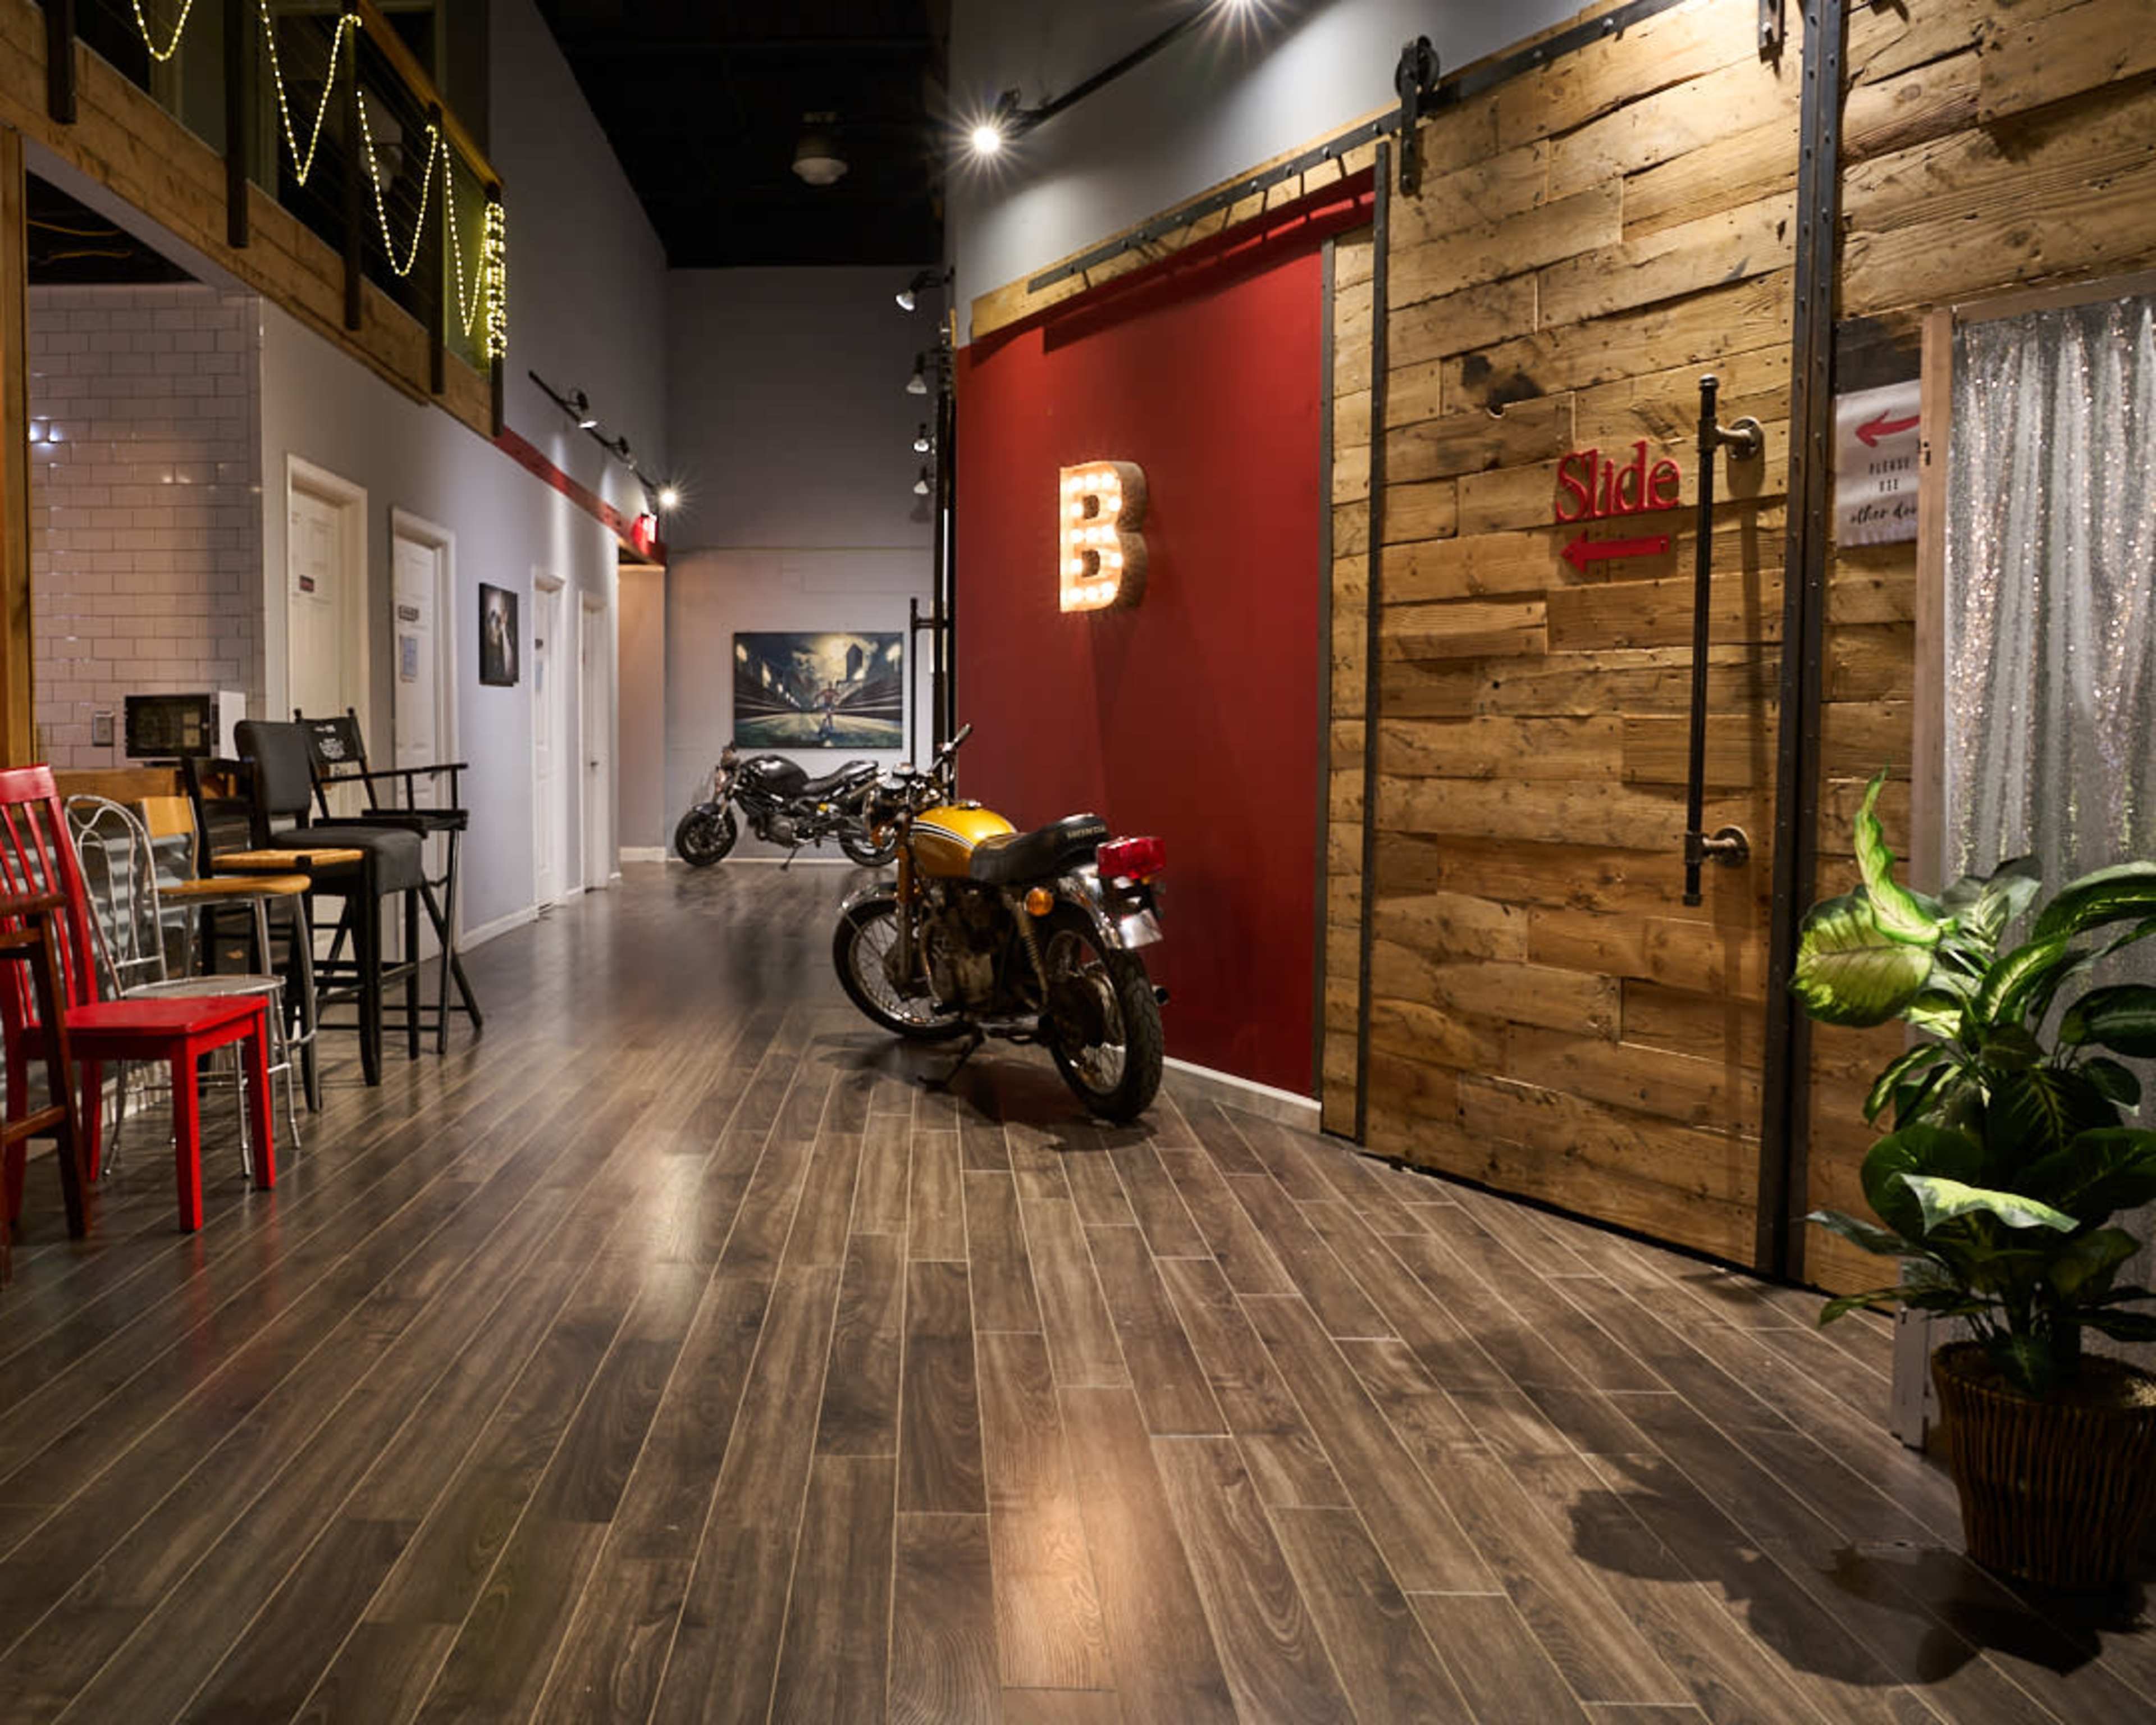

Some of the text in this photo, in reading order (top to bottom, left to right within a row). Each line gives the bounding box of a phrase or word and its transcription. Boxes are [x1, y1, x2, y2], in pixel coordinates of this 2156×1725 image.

[1869, 457, 1910, 474] PLEASE
[1555, 440, 1681, 523] Slide
[1850, 502, 1917, 524] other doo
[1059, 460, 1147, 612] B
[1068, 826, 1106, 839] HONDA
